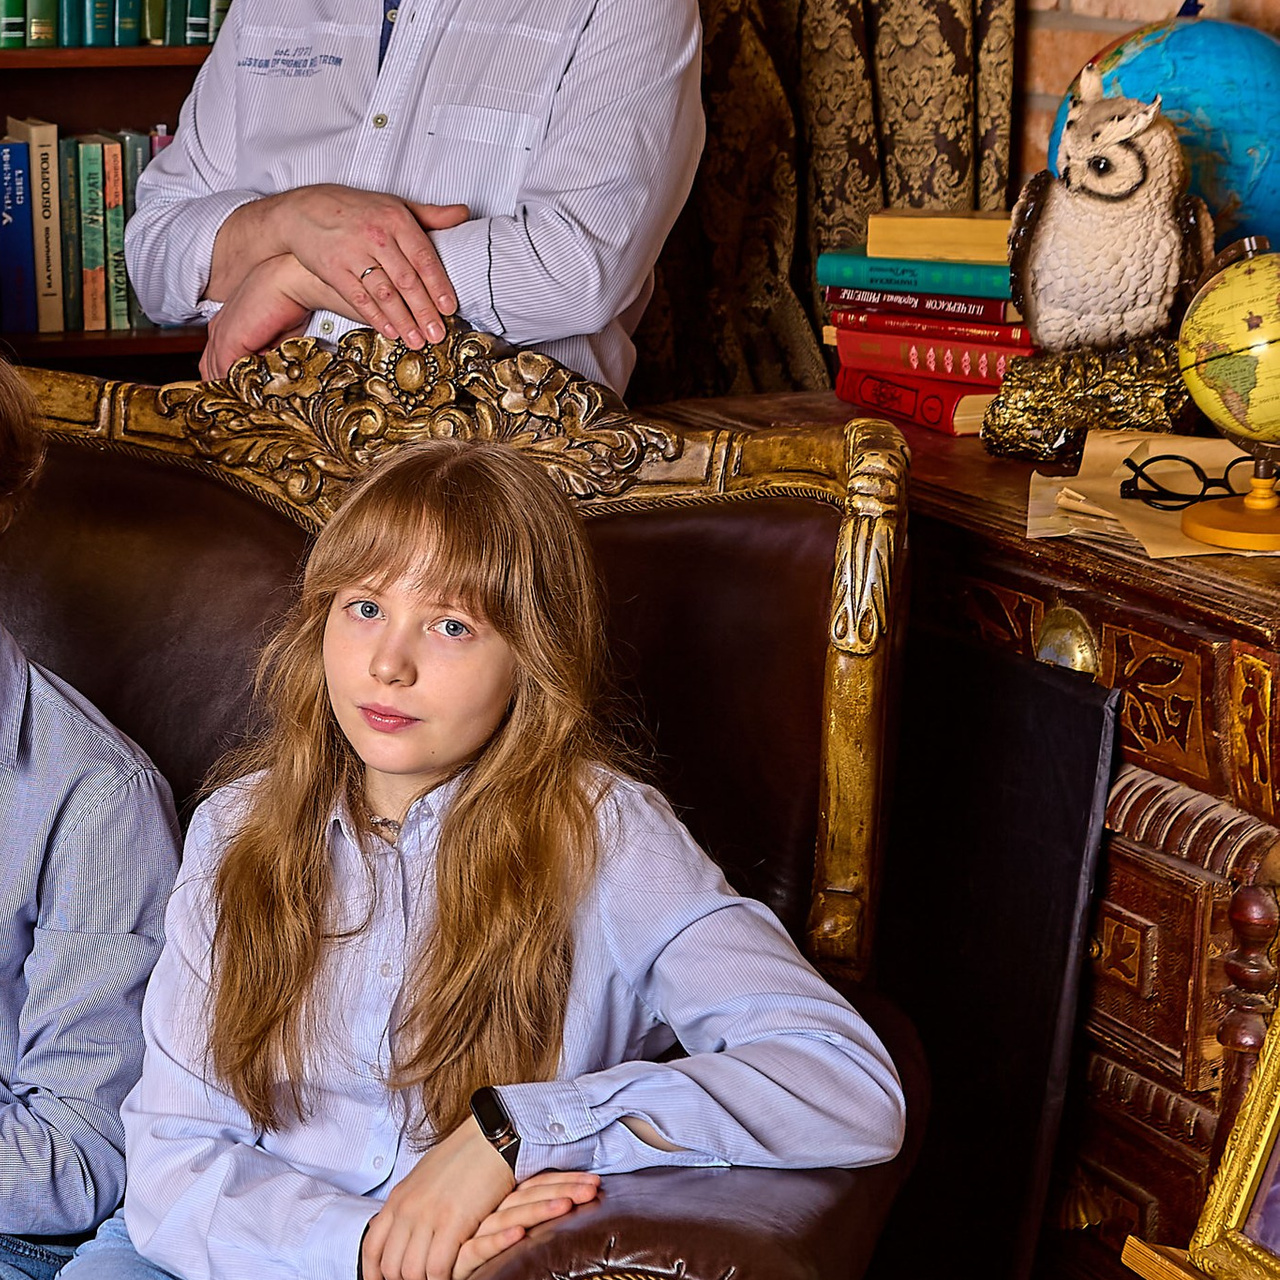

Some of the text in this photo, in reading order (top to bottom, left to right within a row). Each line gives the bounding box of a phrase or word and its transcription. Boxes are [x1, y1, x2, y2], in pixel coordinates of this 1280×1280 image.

[15, 169, 24, 204] СВЕТ
[40, 152, 51, 219] ОБЛОМОВ
[88, 172, 100, 224] ЦУСИМА
[114, 250, 126, 302] ЦУСИМА
[840, 289, 881, 302] РИШЕЛЬЕ
[883, 294, 918, 308] Кардинал
